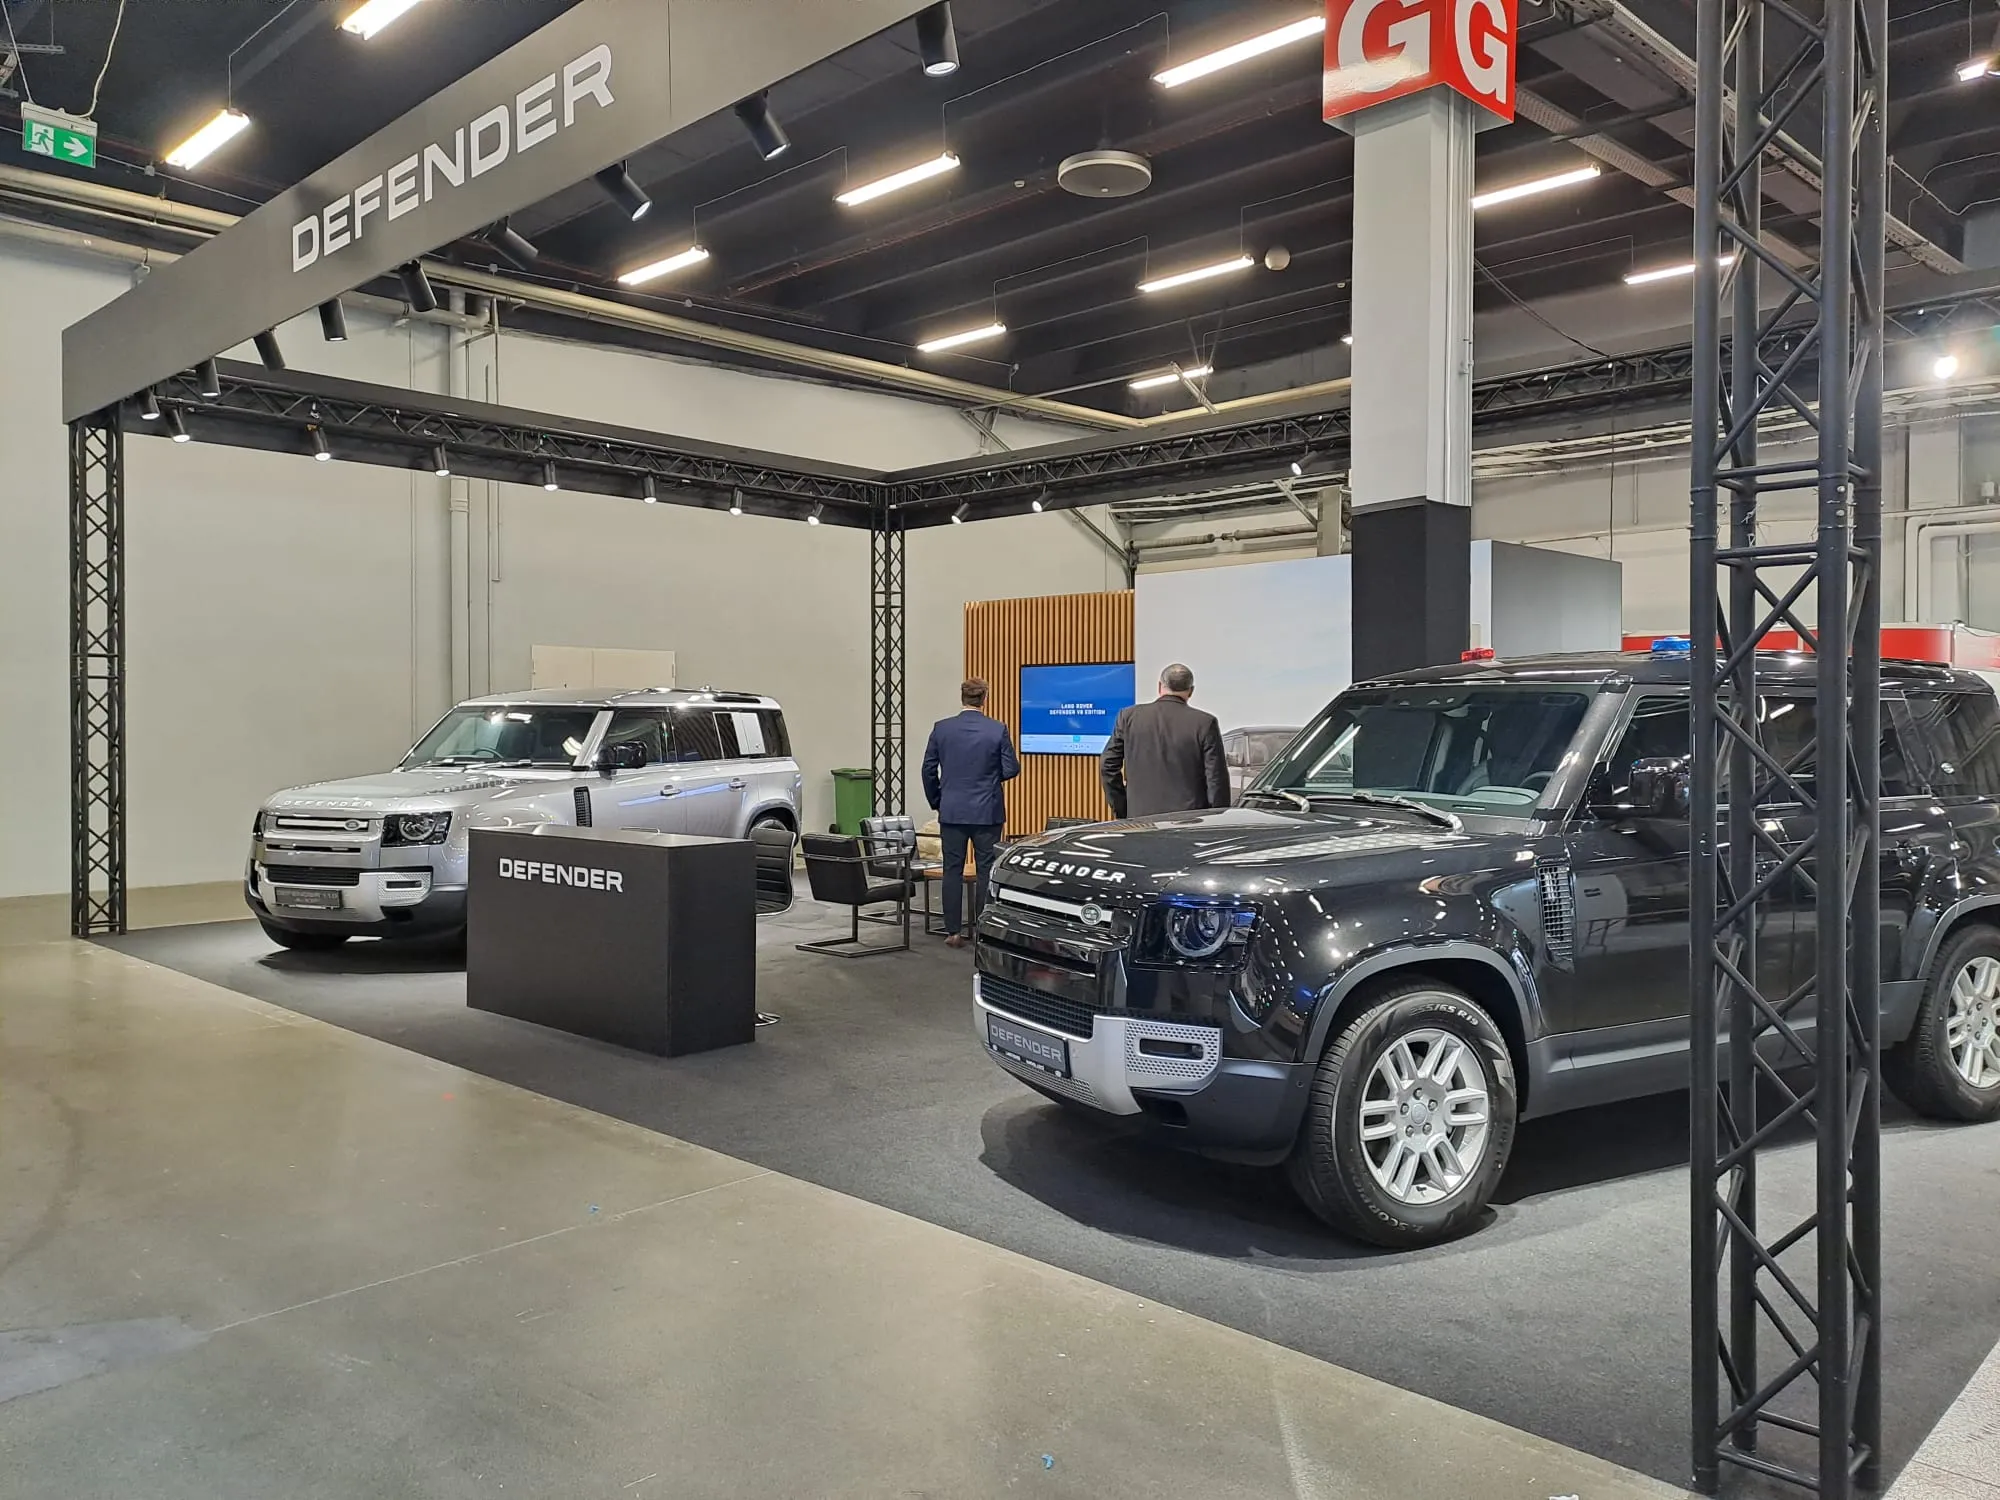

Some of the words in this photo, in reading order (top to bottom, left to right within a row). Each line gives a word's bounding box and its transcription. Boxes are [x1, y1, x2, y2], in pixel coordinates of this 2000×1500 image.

[1338, 0, 1430, 93] G
[1455, 0, 1508, 105] G
[292, 43, 615, 272] DEFENDER
[283, 800, 374, 808] DEFENDER
[499, 858, 623, 893] DEFENDER
[1009, 855, 1126, 883] DEFENDER
[1457, 1009, 1479, 1026] R19
[991, 1025, 1062, 1063] DEFENDER
